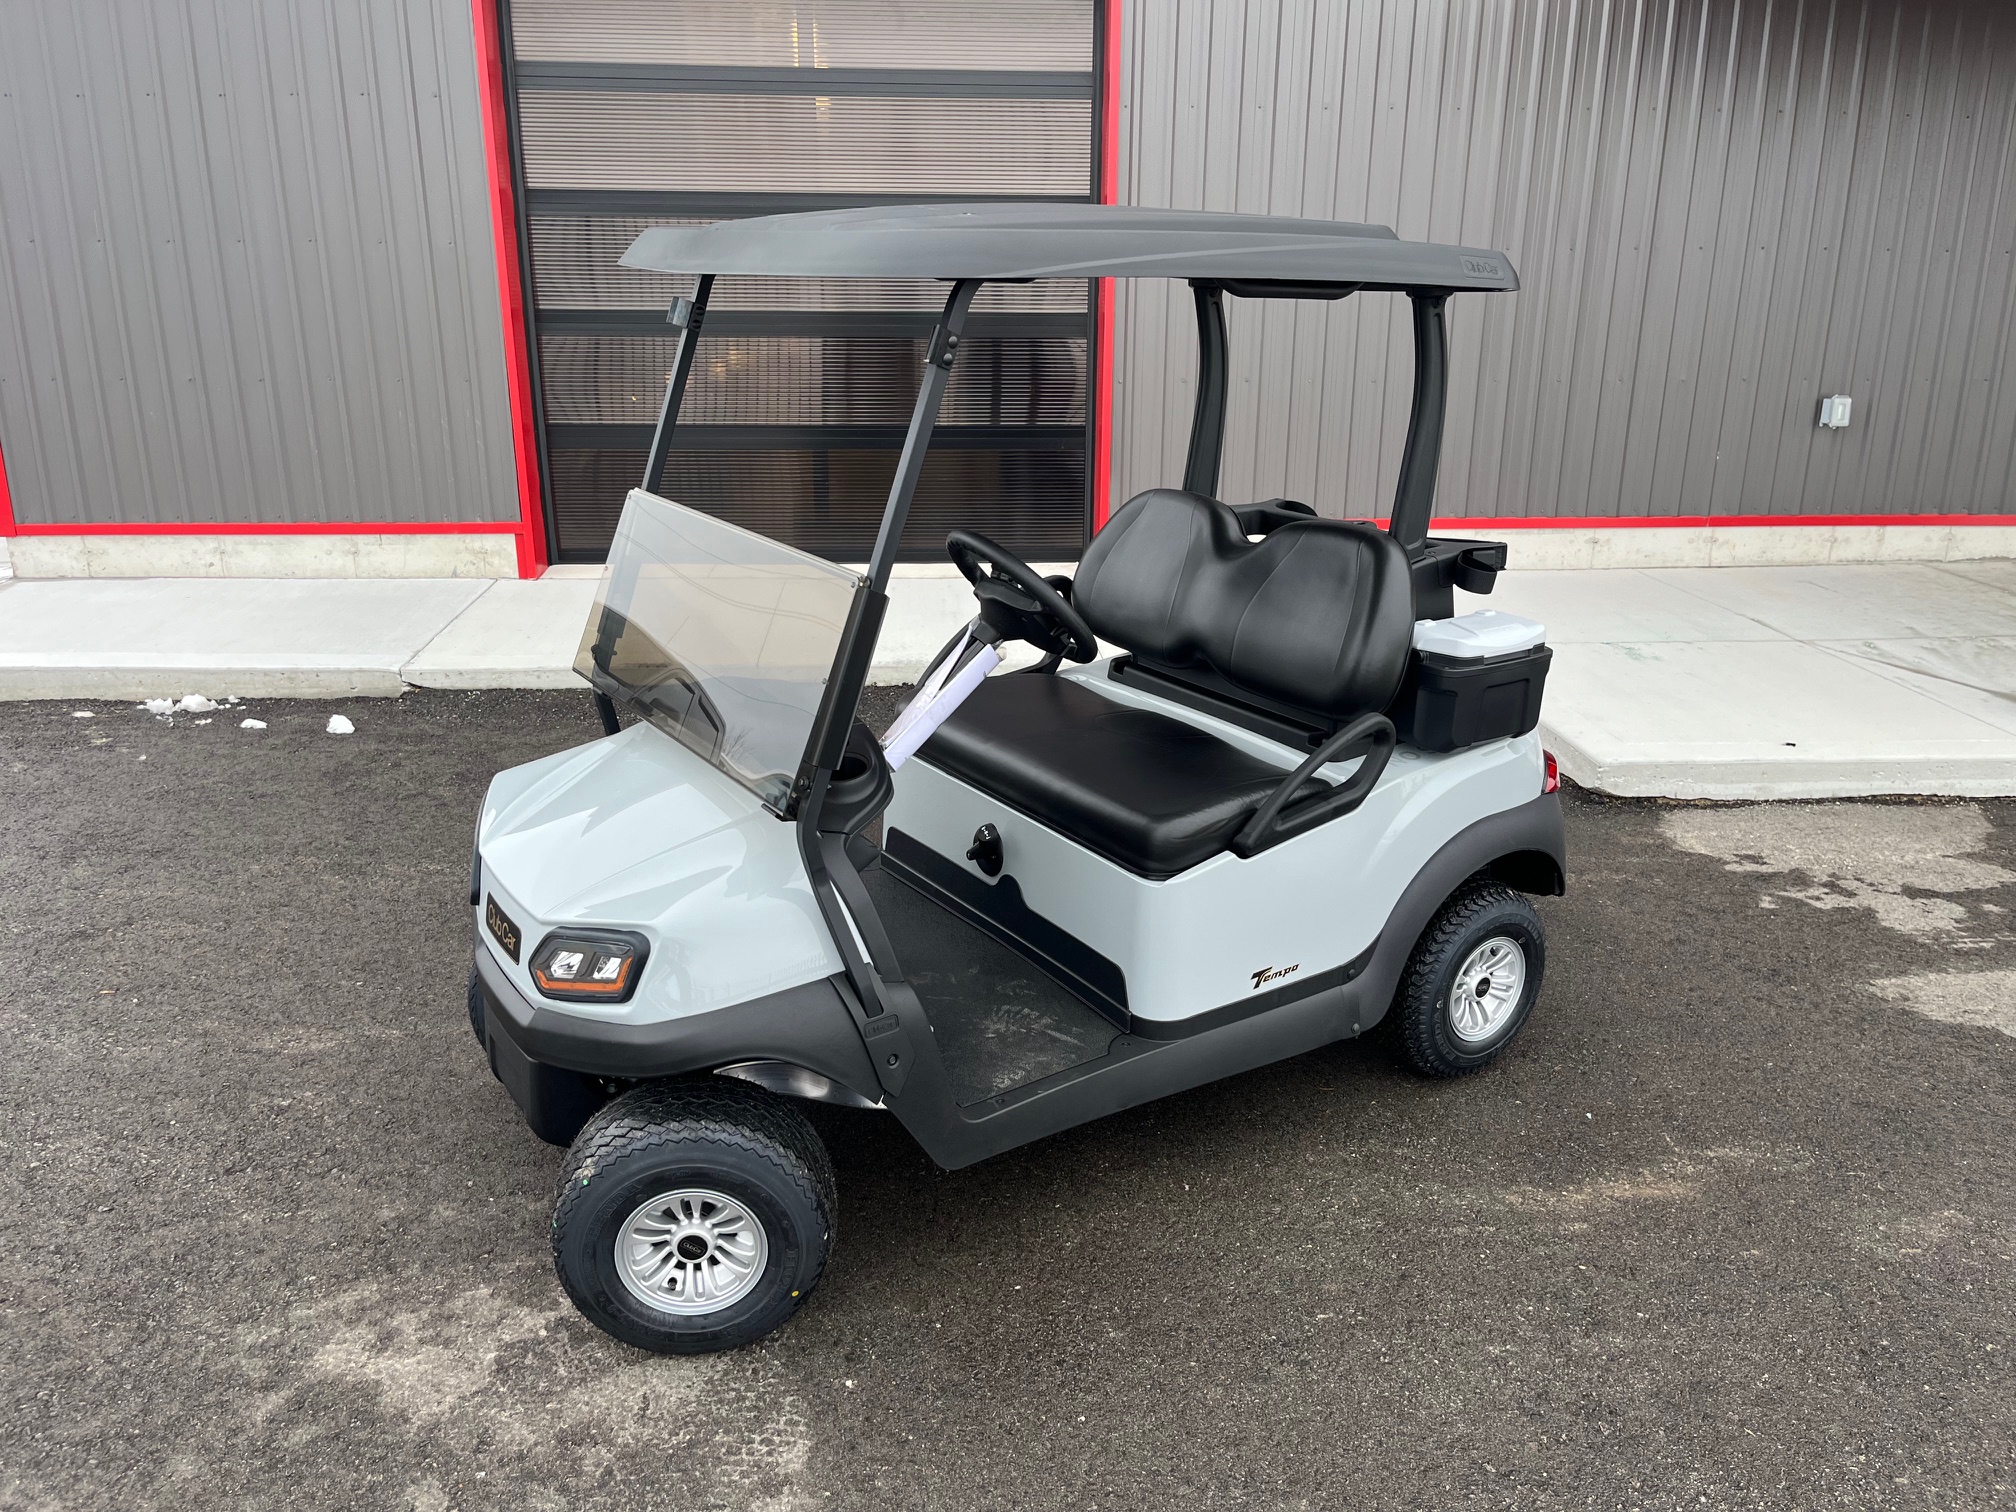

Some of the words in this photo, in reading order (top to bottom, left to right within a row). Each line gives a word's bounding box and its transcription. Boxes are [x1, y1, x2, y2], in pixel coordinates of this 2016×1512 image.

[488, 904, 502, 937] Club
[501, 920, 516, 952] Car
[1250, 963, 1300, 990] Tempo
